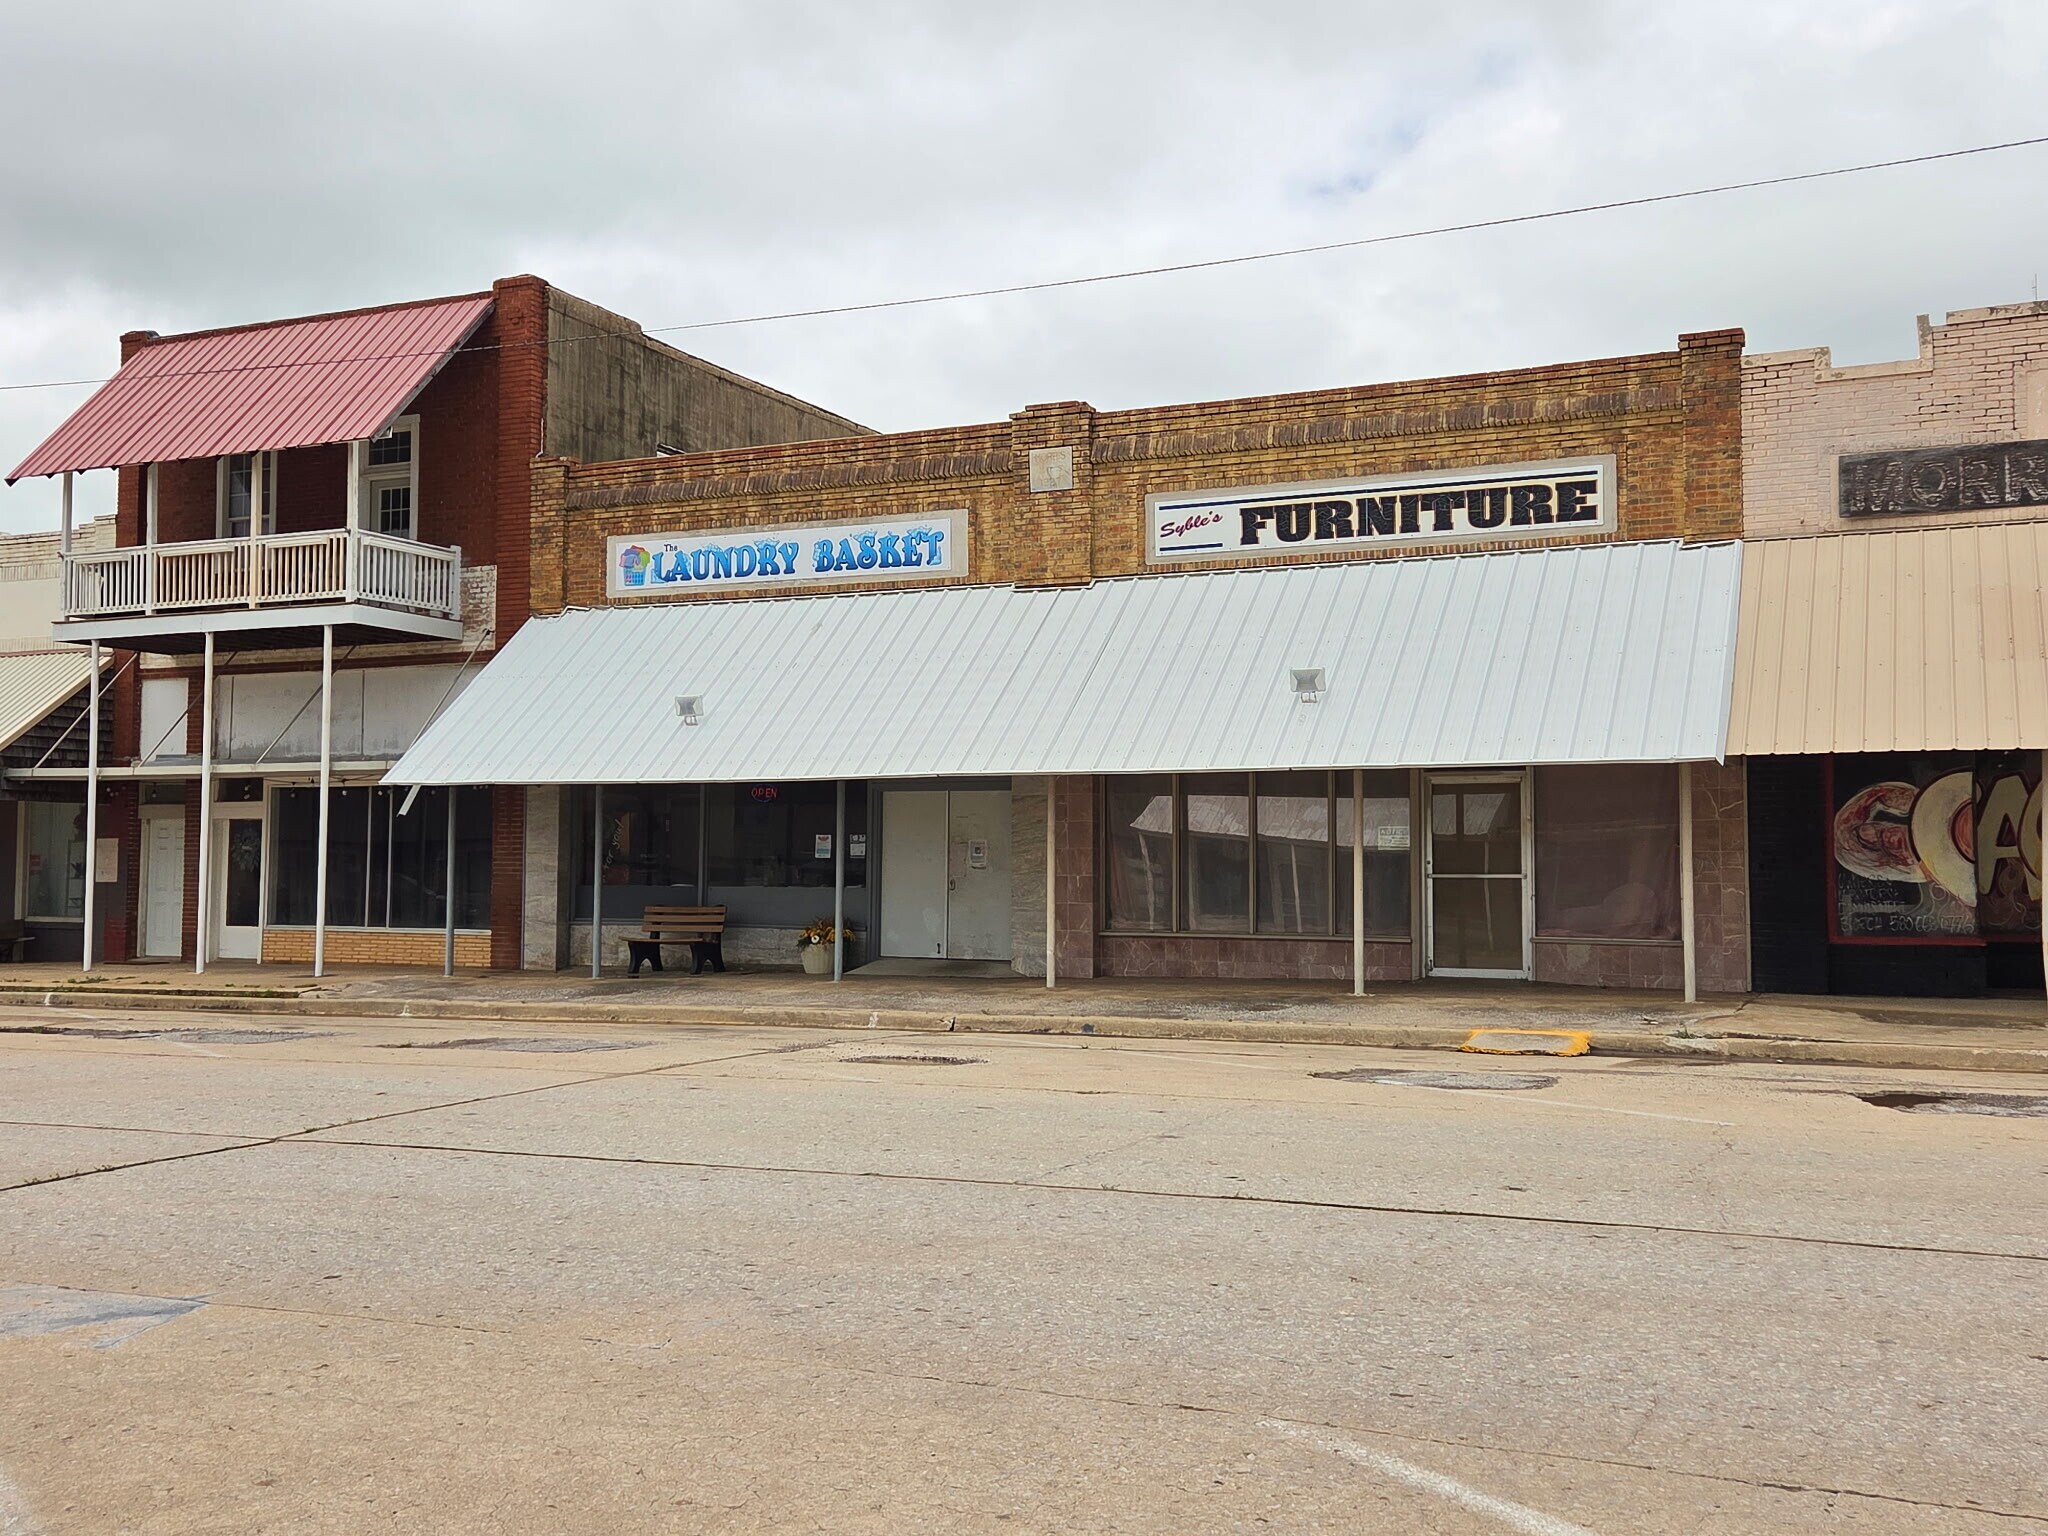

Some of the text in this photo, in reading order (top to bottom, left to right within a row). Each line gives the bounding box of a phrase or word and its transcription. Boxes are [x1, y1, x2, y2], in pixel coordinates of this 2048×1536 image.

[1160, 511, 1223, 539] Syble's
[1239, 479, 1599, 546] FURNITURE
[651, 528, 945, 584] LAUNDRY BASKET
[664, 543, 678, 552] The
[751, 787, 777, 798] OPEN
